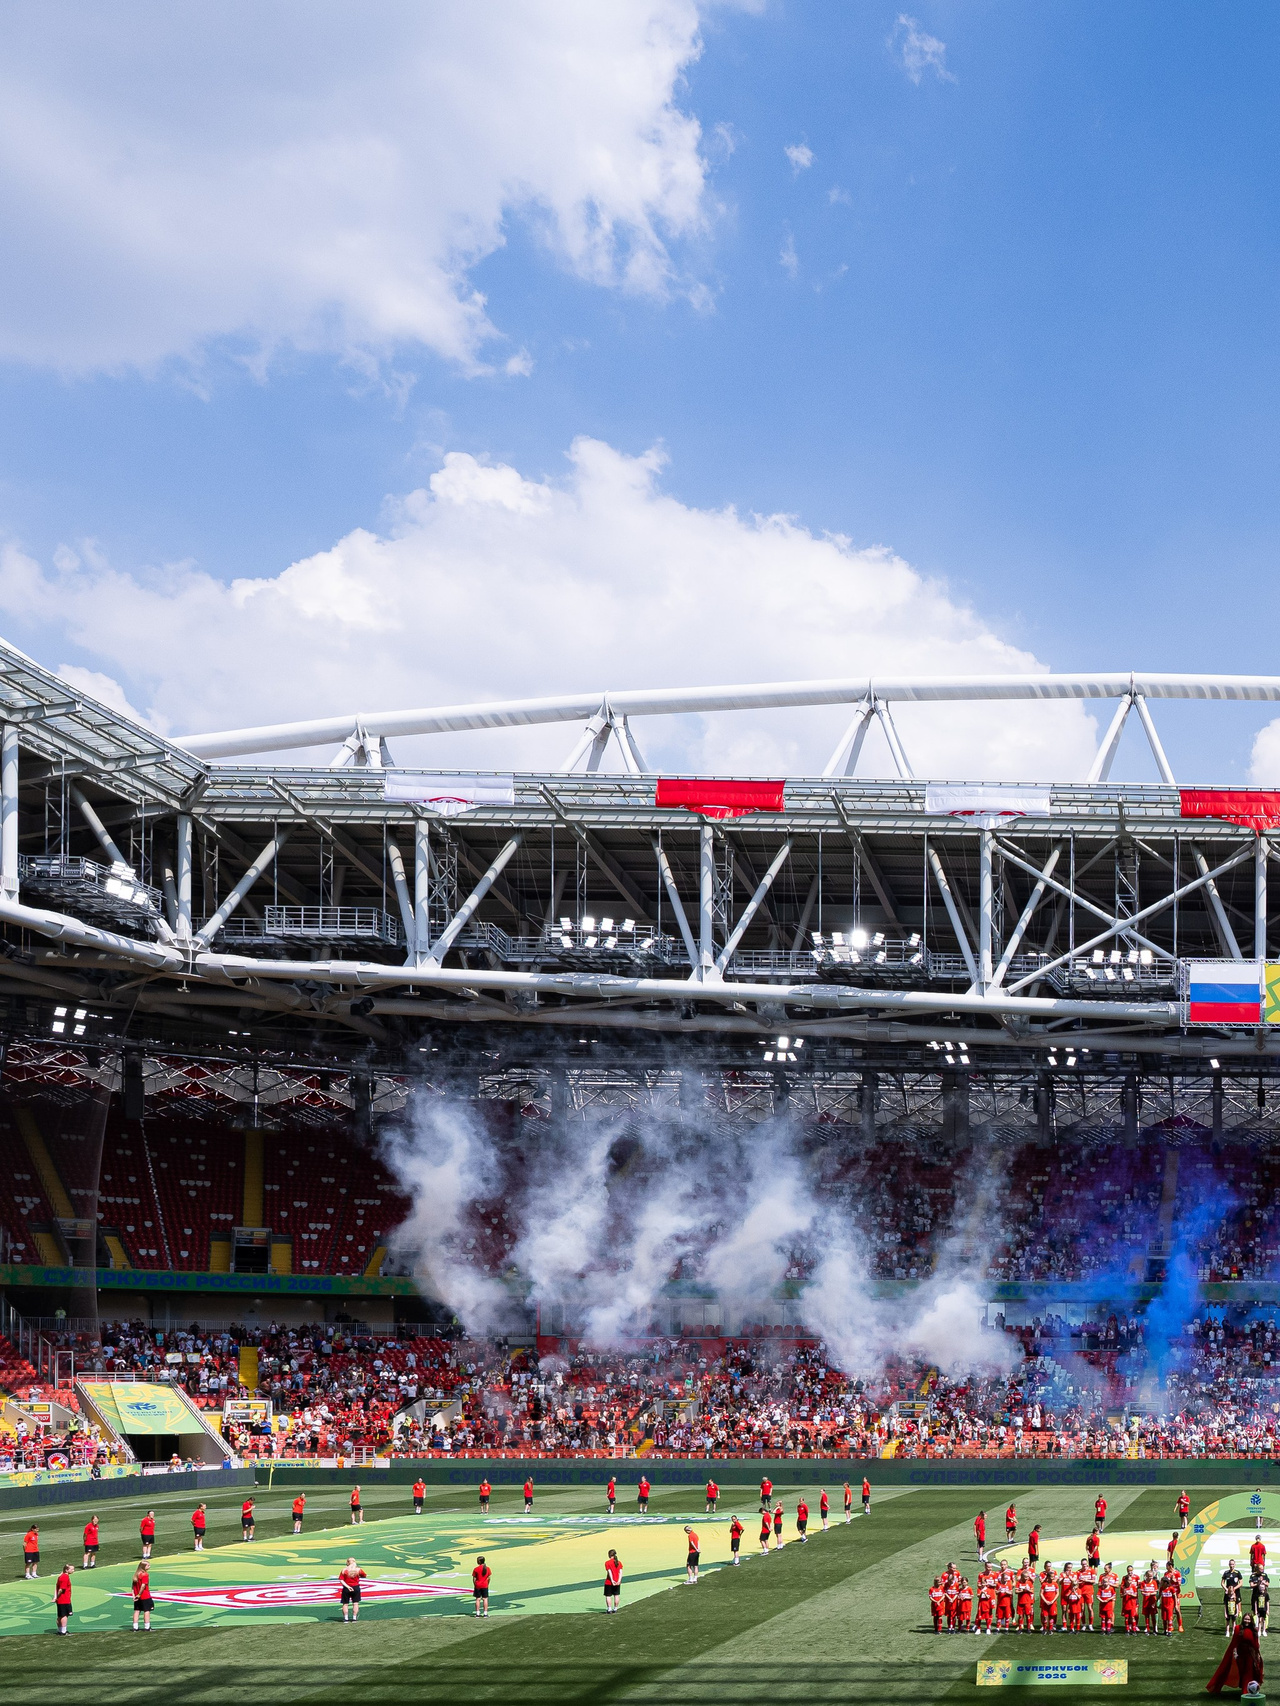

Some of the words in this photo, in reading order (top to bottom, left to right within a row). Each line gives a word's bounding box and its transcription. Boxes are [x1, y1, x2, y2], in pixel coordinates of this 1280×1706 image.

[197, 1275, 281, 1289] РОССИИ
[289, 1278, 333, 1291] 2026
[580, 1470, 656, 1483] РОССИИ
[661, 1470, 704, 1483] 2026
[910, 1470, 1032, 1483] СУПЕРКУБОК
[1036, 1470, 1111, 1483] РОССИИ
[1117, 1470, 1157, 1483] 2026
